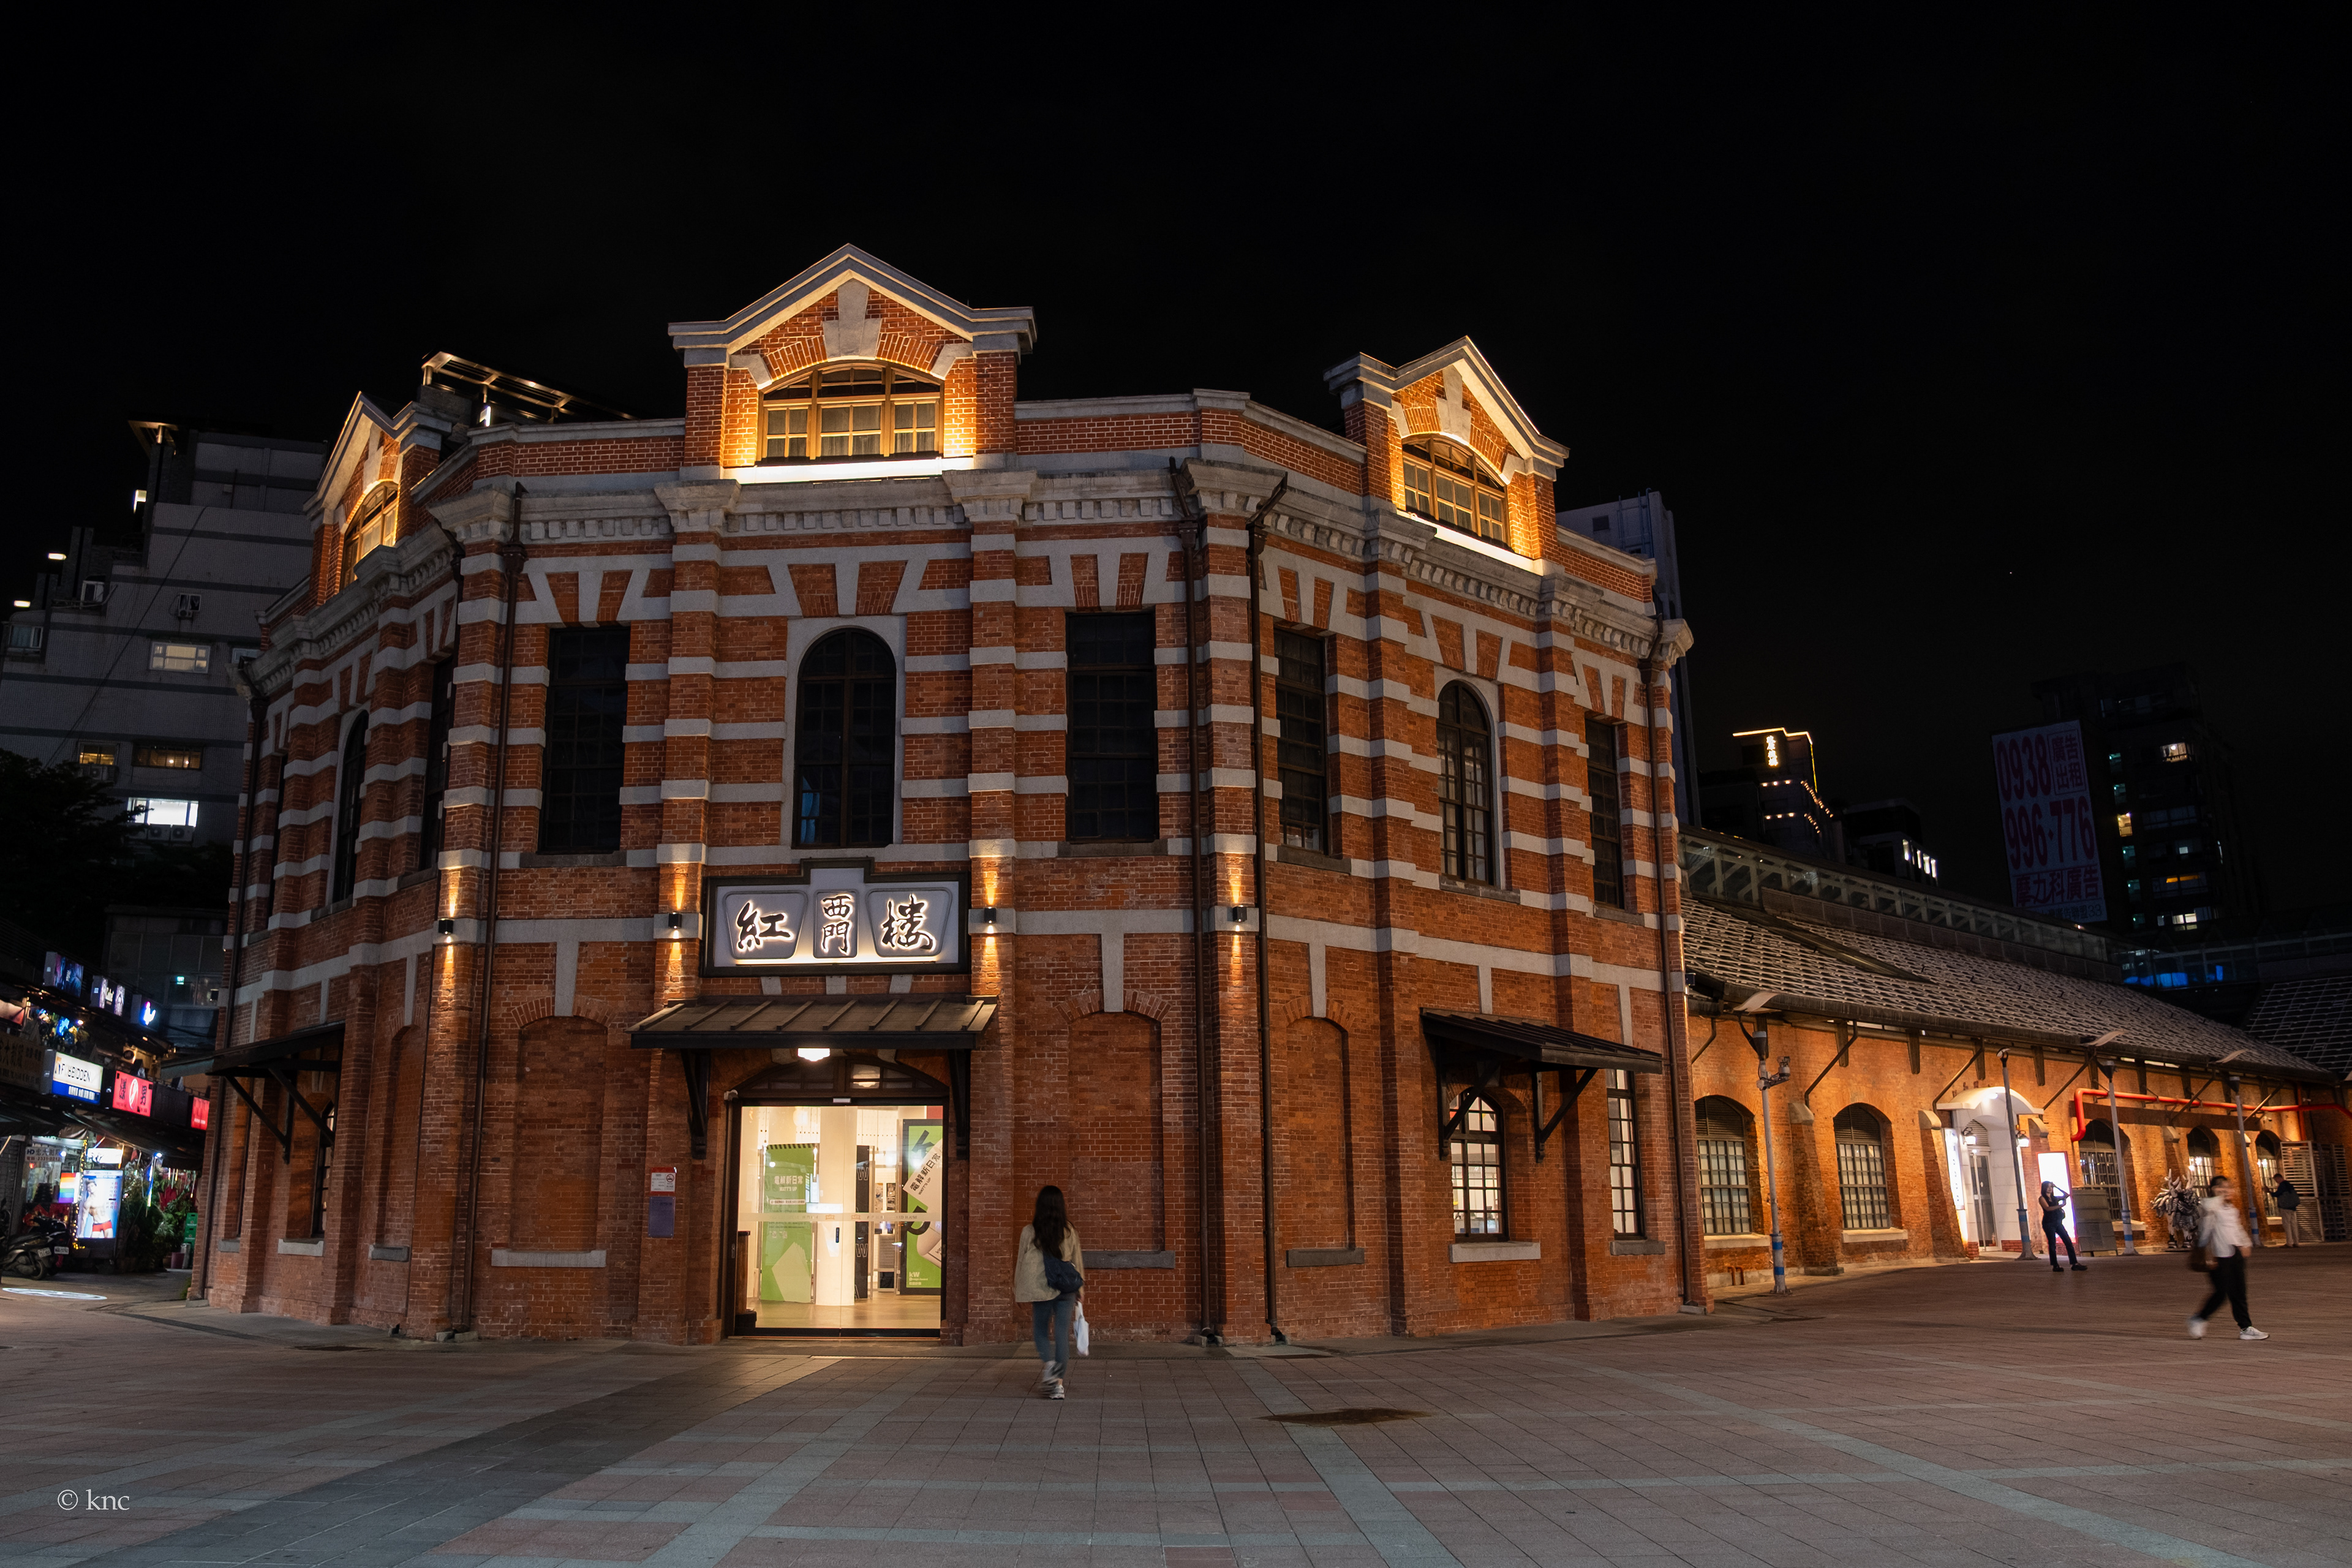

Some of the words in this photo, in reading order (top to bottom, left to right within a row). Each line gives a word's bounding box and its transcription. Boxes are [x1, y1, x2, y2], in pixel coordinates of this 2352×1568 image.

[1997, 734, 2051, 802] 0938
[2056, 762, 2083, 790] 出租
[822, 895, 851, 953] 西門
[910, 1153, 941, 1191] 電解新日常
